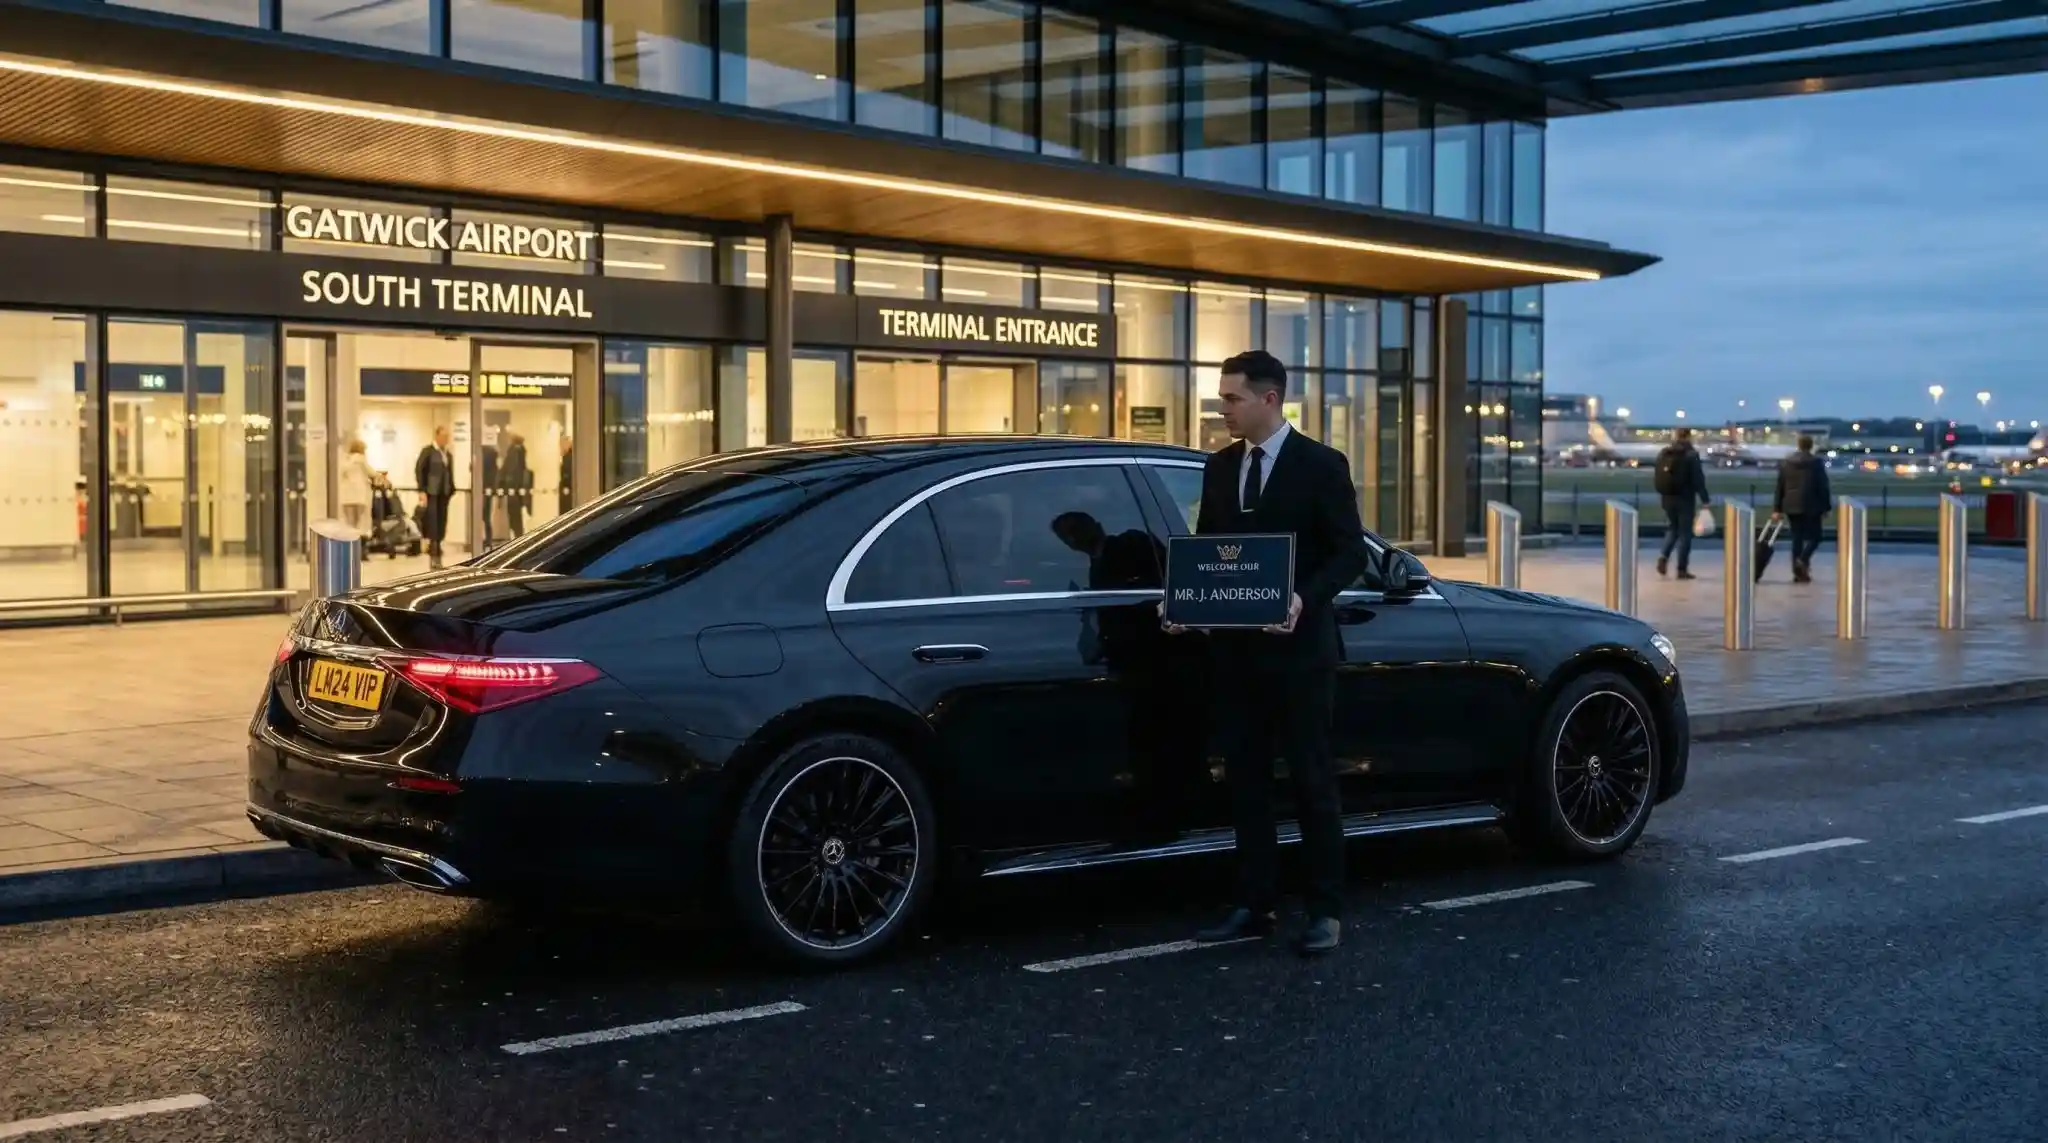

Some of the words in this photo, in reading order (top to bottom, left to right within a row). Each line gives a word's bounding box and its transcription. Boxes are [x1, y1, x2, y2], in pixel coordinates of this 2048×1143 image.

[287, 205, 449, 249] GATWICK
[458, 221, 595, 260] AIRPORT
[302, 270, 421, 308] SOUTH
[432, 278, 592, 318] TERMINAL
[879, 309, 990, 341] TERMINAL
[995, 316, 1098, 347] ENTRANCE
[1197, 563, 1239, 571] WELCOME
[1240, 562, 1260, 571] OUR
[1210, 587, 1280, 601] ANDERSON
[354, 672, 378, 702] VIP
